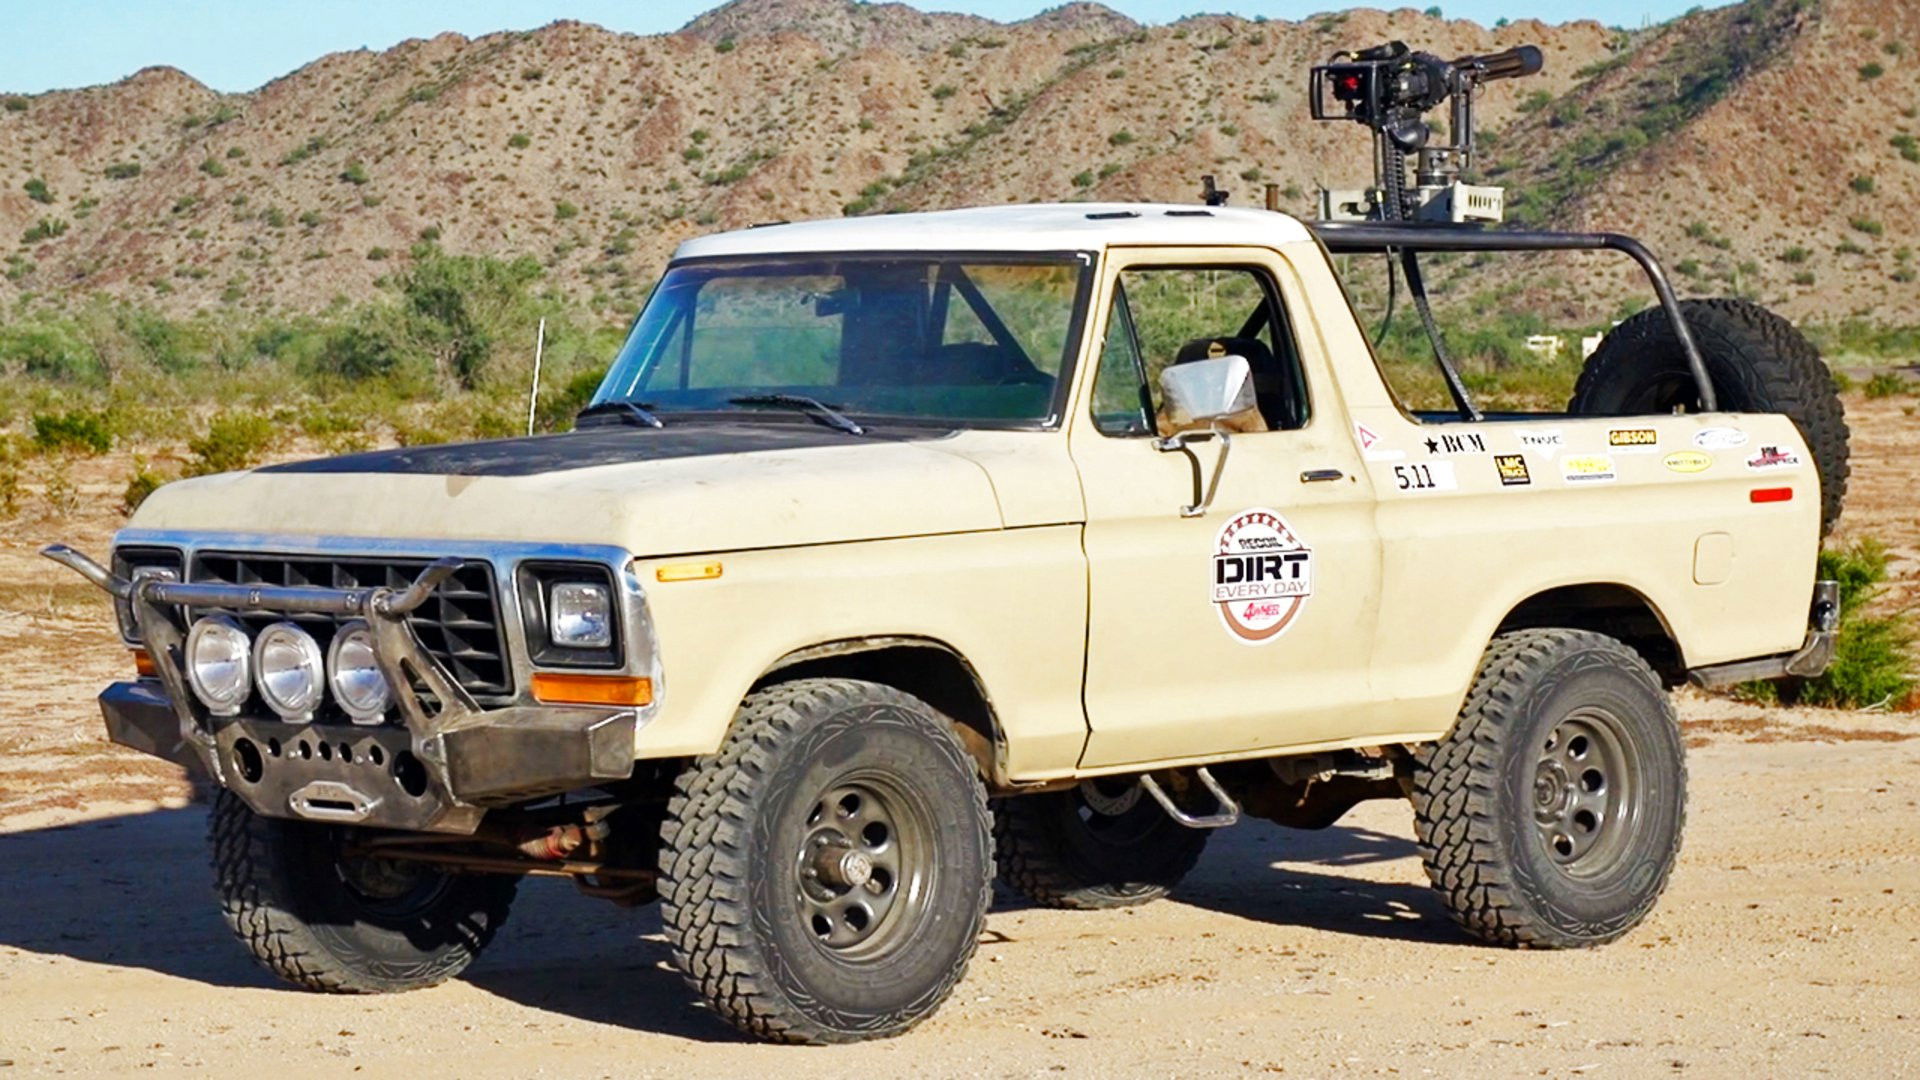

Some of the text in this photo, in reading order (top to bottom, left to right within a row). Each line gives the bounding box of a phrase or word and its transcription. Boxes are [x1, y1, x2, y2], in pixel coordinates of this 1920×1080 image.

[1610, 431, 1656, 445] GIBSON
[1496, 457, 1525, 468] LMC
[1394, 464, 1436, 490] 5.11
[1238, 537, 1284, 550] RECOIL
[1216, 553, 1309, 584] DIRT
[1216, 581, 1308, 599] EVERY DAY
